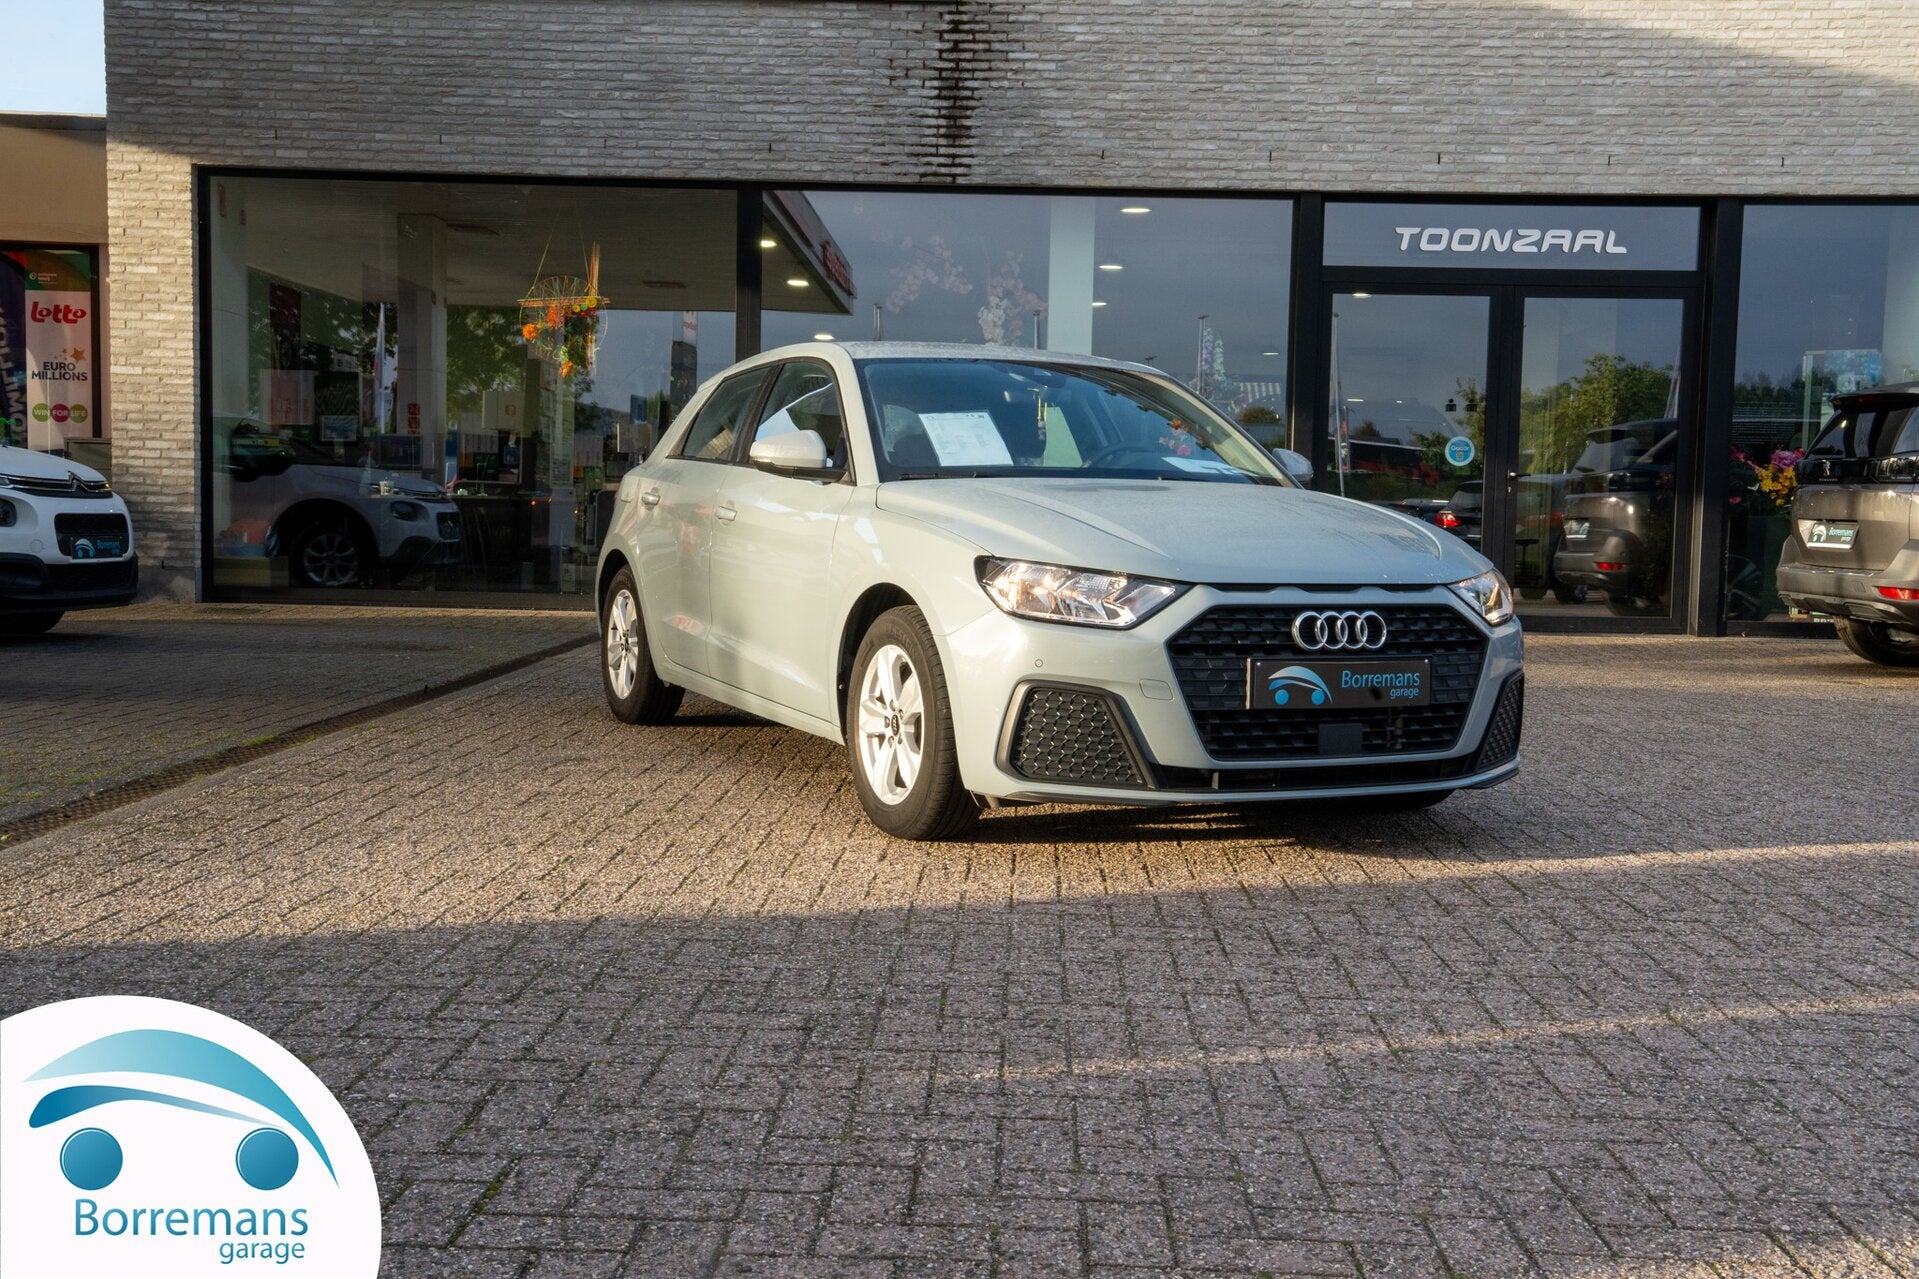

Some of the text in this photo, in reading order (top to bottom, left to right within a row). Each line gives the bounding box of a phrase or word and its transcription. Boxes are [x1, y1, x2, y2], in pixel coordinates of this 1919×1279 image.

[1395, 227, 1627, 254] TOONZAAL
[31, 301, 87, 324] Lotto
[43, 361, 76, 371] EURO
[31, 371, 88, 381] MILLIONS
[1341, 670, 1420, 688] Borremans
[1390, 688, 1419, 699] garage
